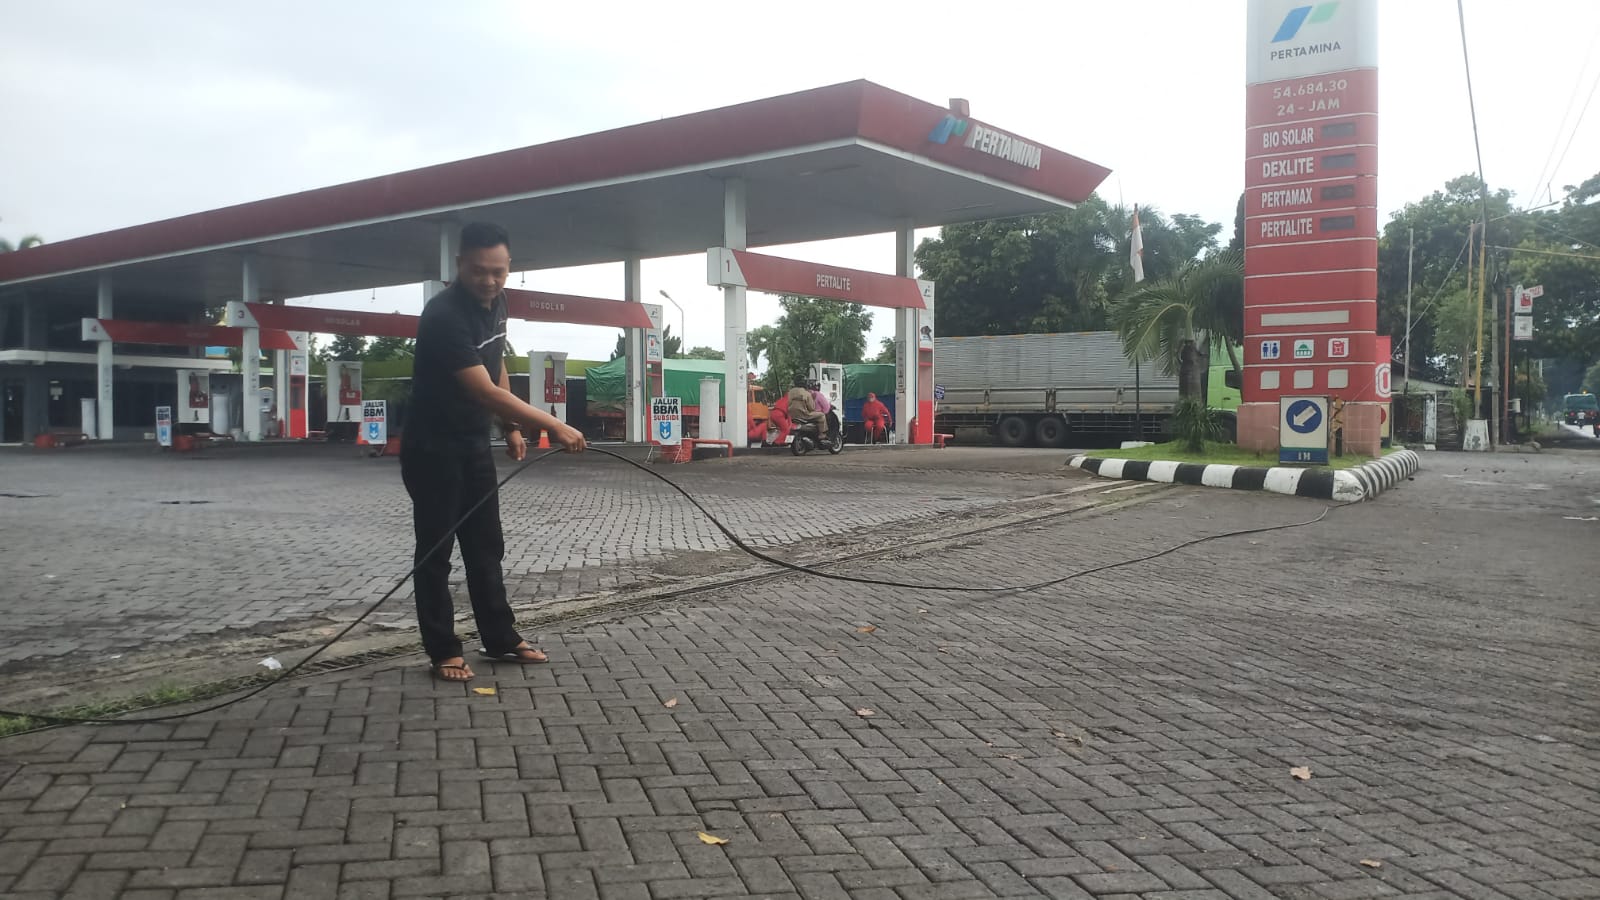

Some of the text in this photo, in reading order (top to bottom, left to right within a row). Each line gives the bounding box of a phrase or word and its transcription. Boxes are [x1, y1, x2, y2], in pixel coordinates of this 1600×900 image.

[1270, 41, 1342, 61] PERTAMINA
[1272, 79, 1347, 99] 54.684.30
[1277, 103, 1295, 116] 24
[1308, 98, 1340, 112] JAM
[971, 125, 1042, 171] PERTAMINA
[1263, 128, 1314, 148] BIO SOLAR
[1262, 157, 1314, 178] DEXLITE
[1261, 187, 1313, 208] PERTAMAX
[1261, 217, 1313, 238] PERTALITE
[725, 259, 731, 273] 1
[816, 273, 851, 291] PERTALITE
[363, 408, 384, 417] BBM
[653, 405, 679, 414] BBM
